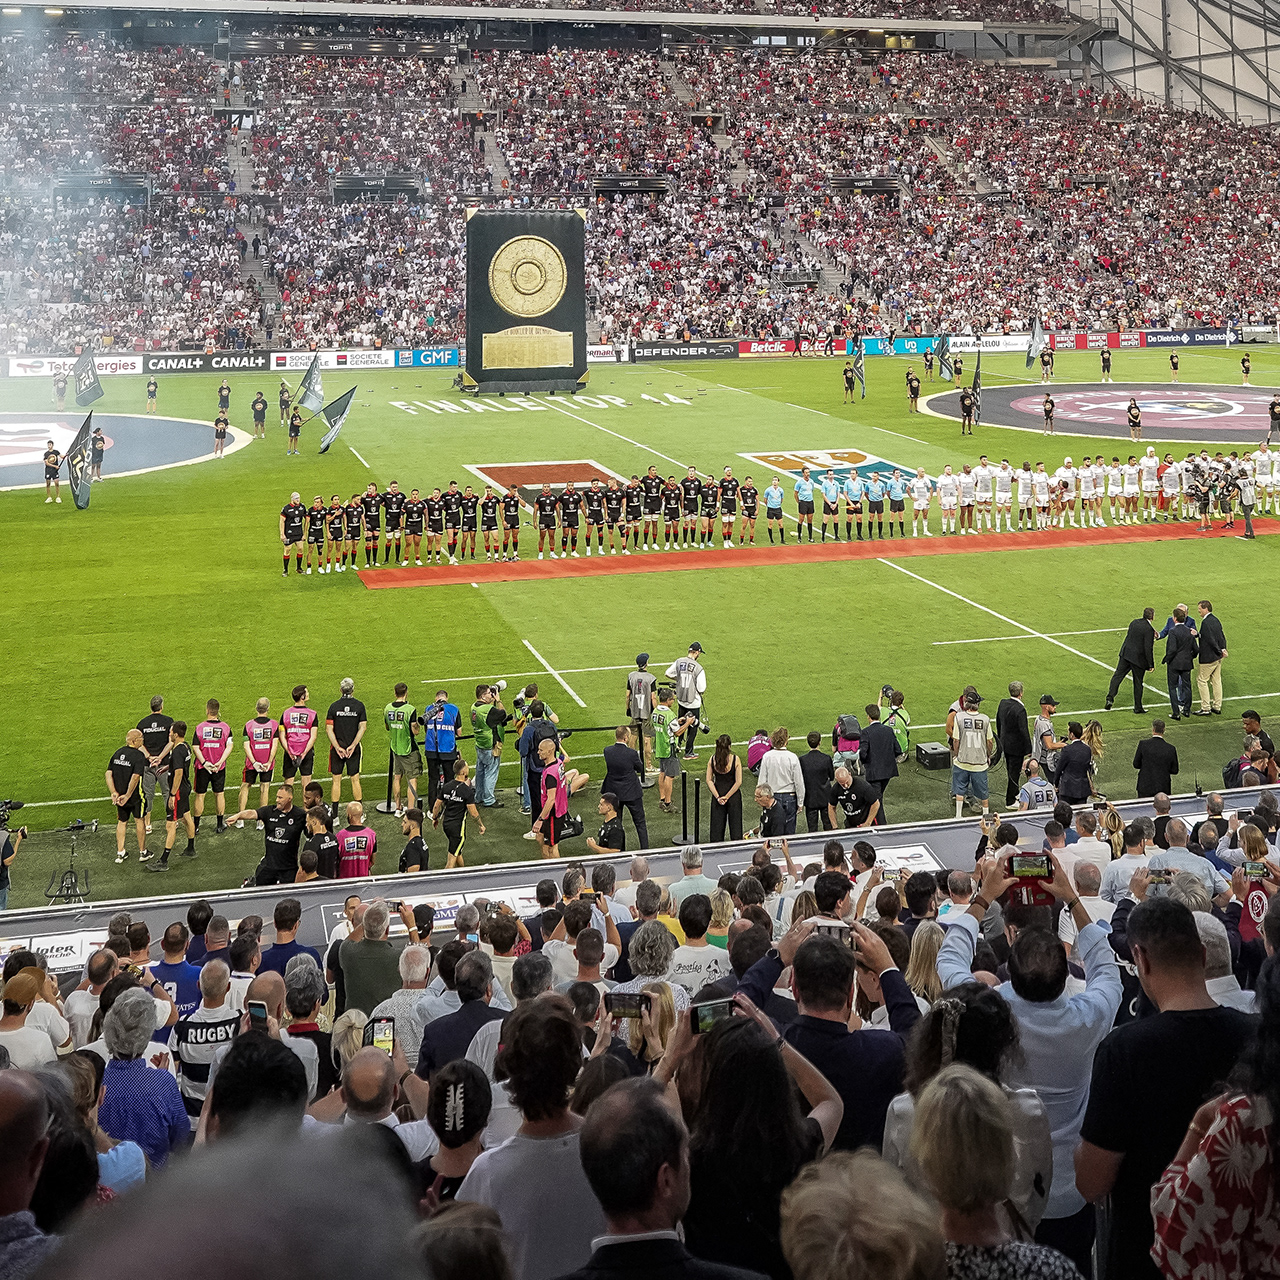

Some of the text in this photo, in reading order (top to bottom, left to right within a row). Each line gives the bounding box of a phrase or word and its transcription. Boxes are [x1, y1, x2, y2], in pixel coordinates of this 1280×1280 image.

[634, 347, 708, 357] DEFENDER
[750, 342, 786, 352] Betclic
[148, 354, 266, 370] CANAL+ CANAL+
[420, 352, 452, 364] GMF
[388, 396, 548, 415] FINALE
[548, 395, 628, 410] TOP
[188, 1023, 236, 1044] RUGBY
